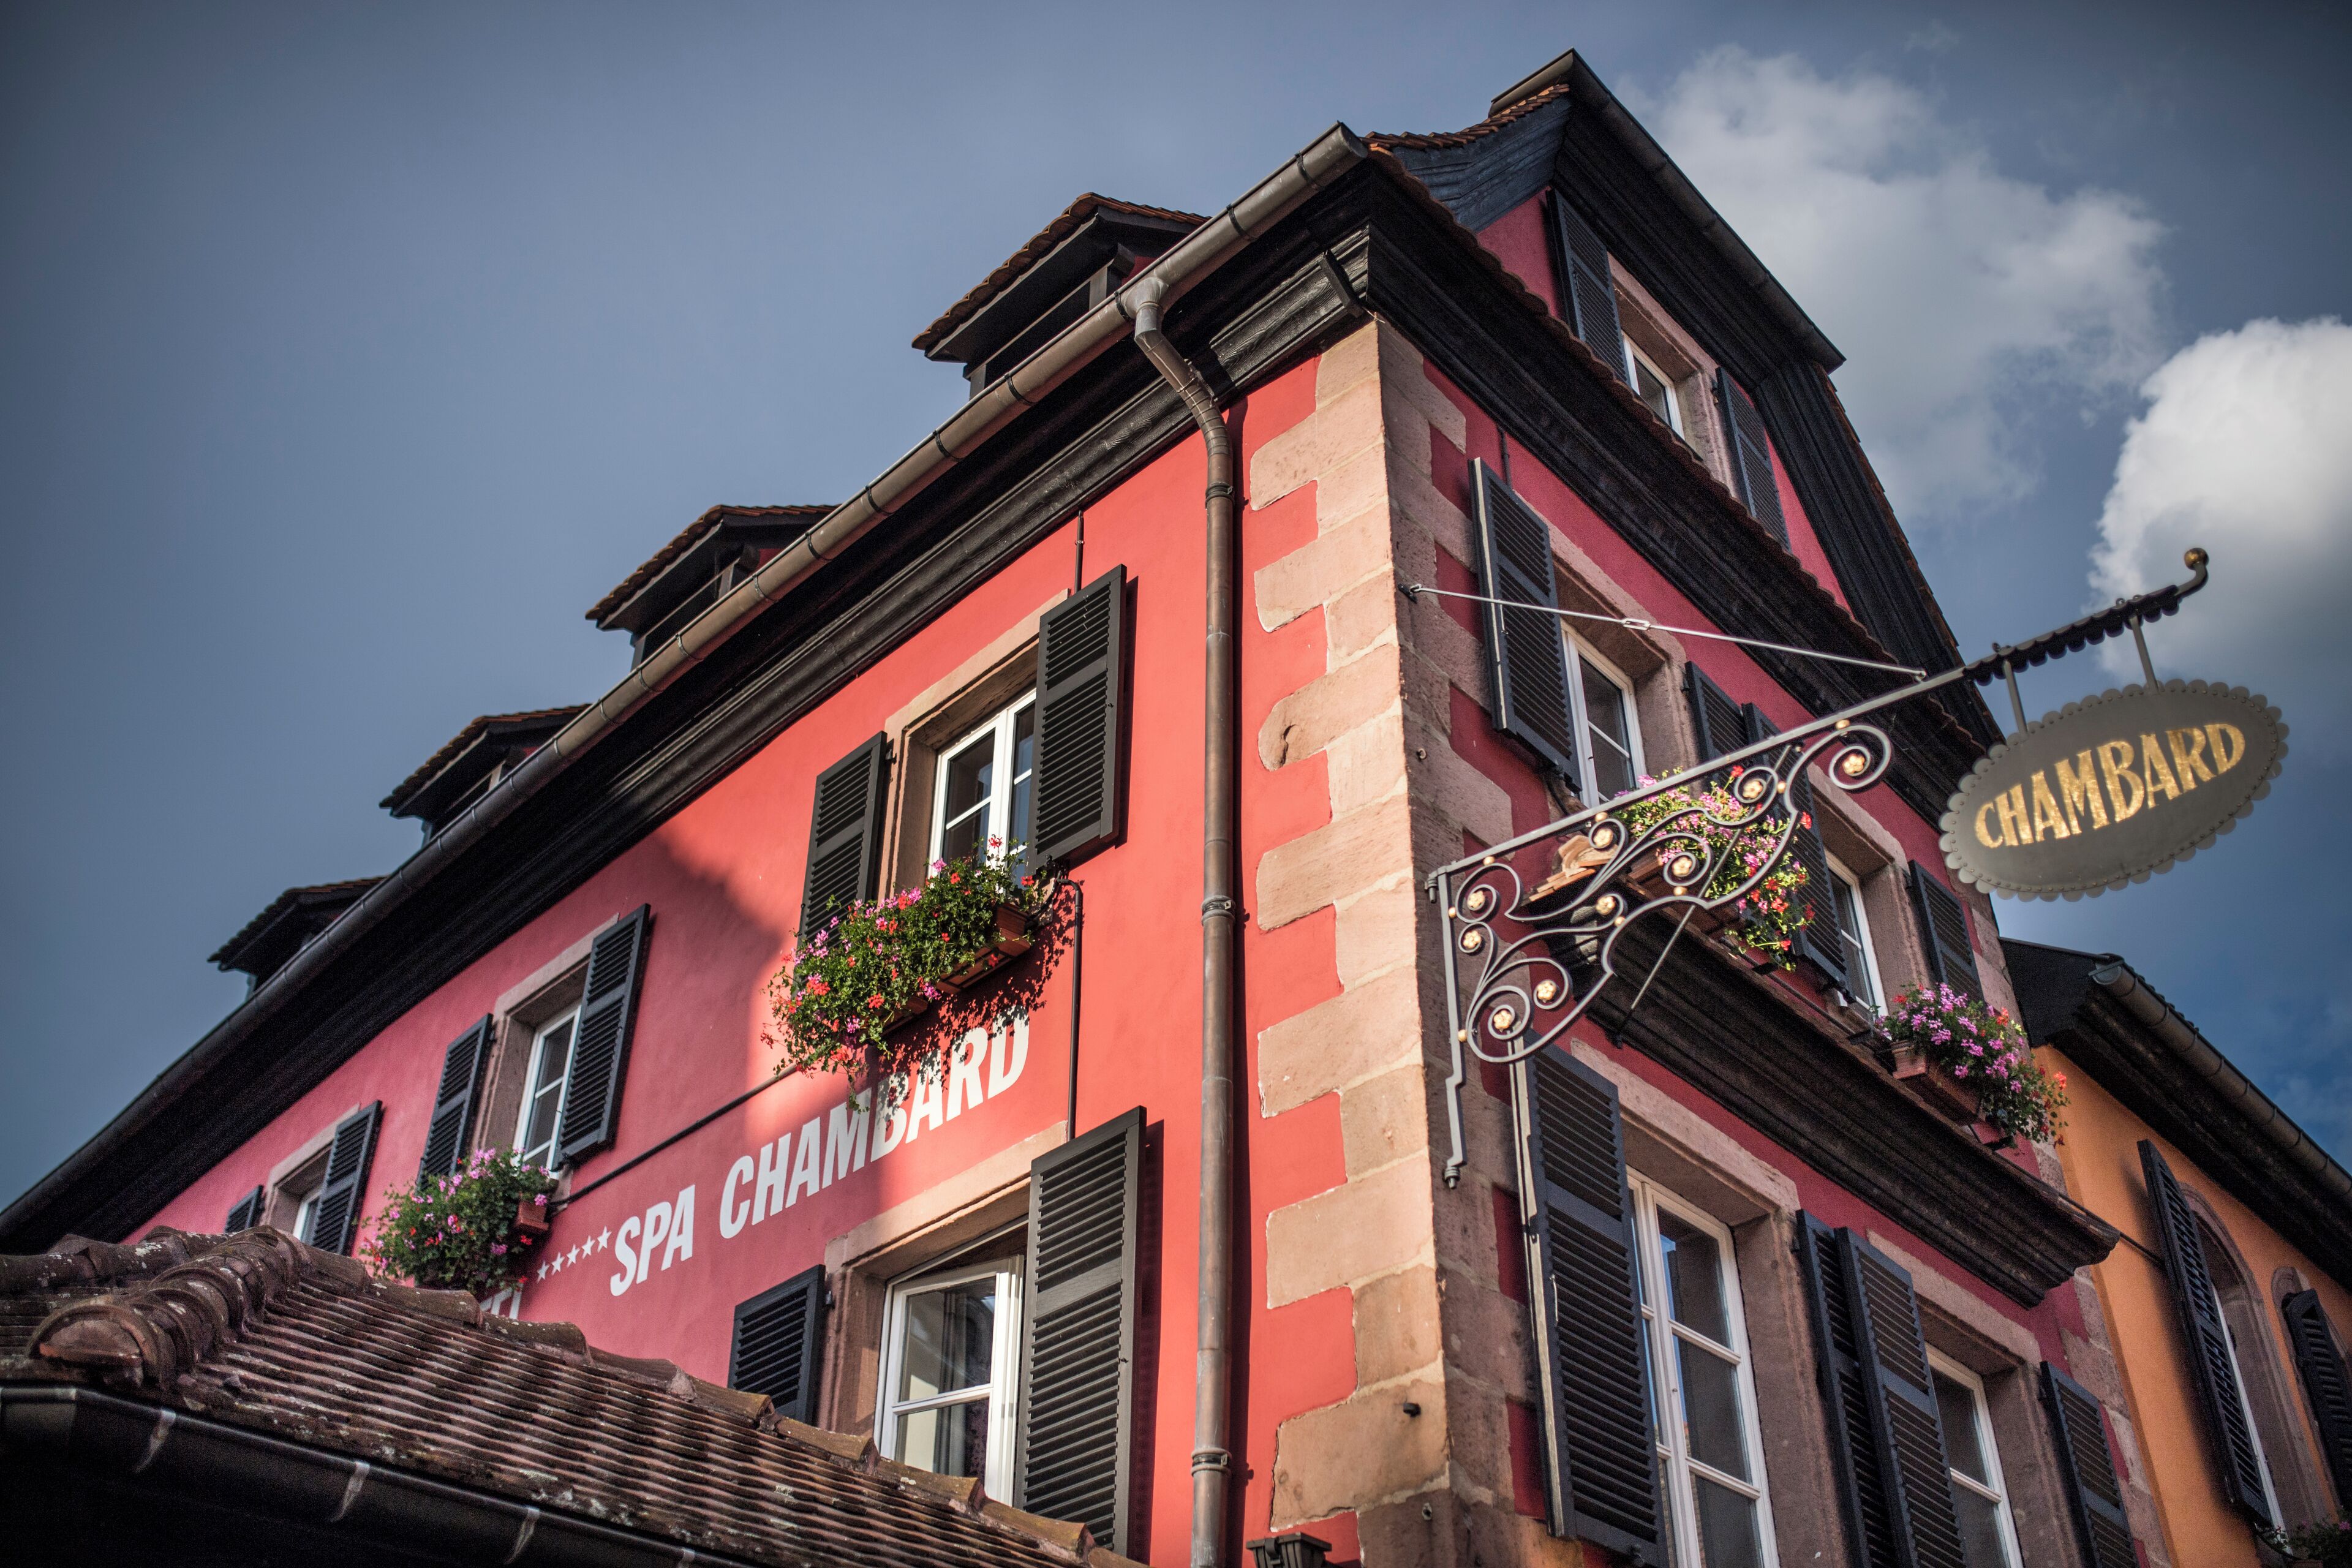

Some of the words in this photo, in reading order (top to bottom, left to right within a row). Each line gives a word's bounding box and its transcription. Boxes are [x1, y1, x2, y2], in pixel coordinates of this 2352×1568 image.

[1974, 723, 2246, 848] CHAMBARD
[610, 1184, 695, 1297] SPA
[719, 1005, 1030, 1240] CHAMBARD
